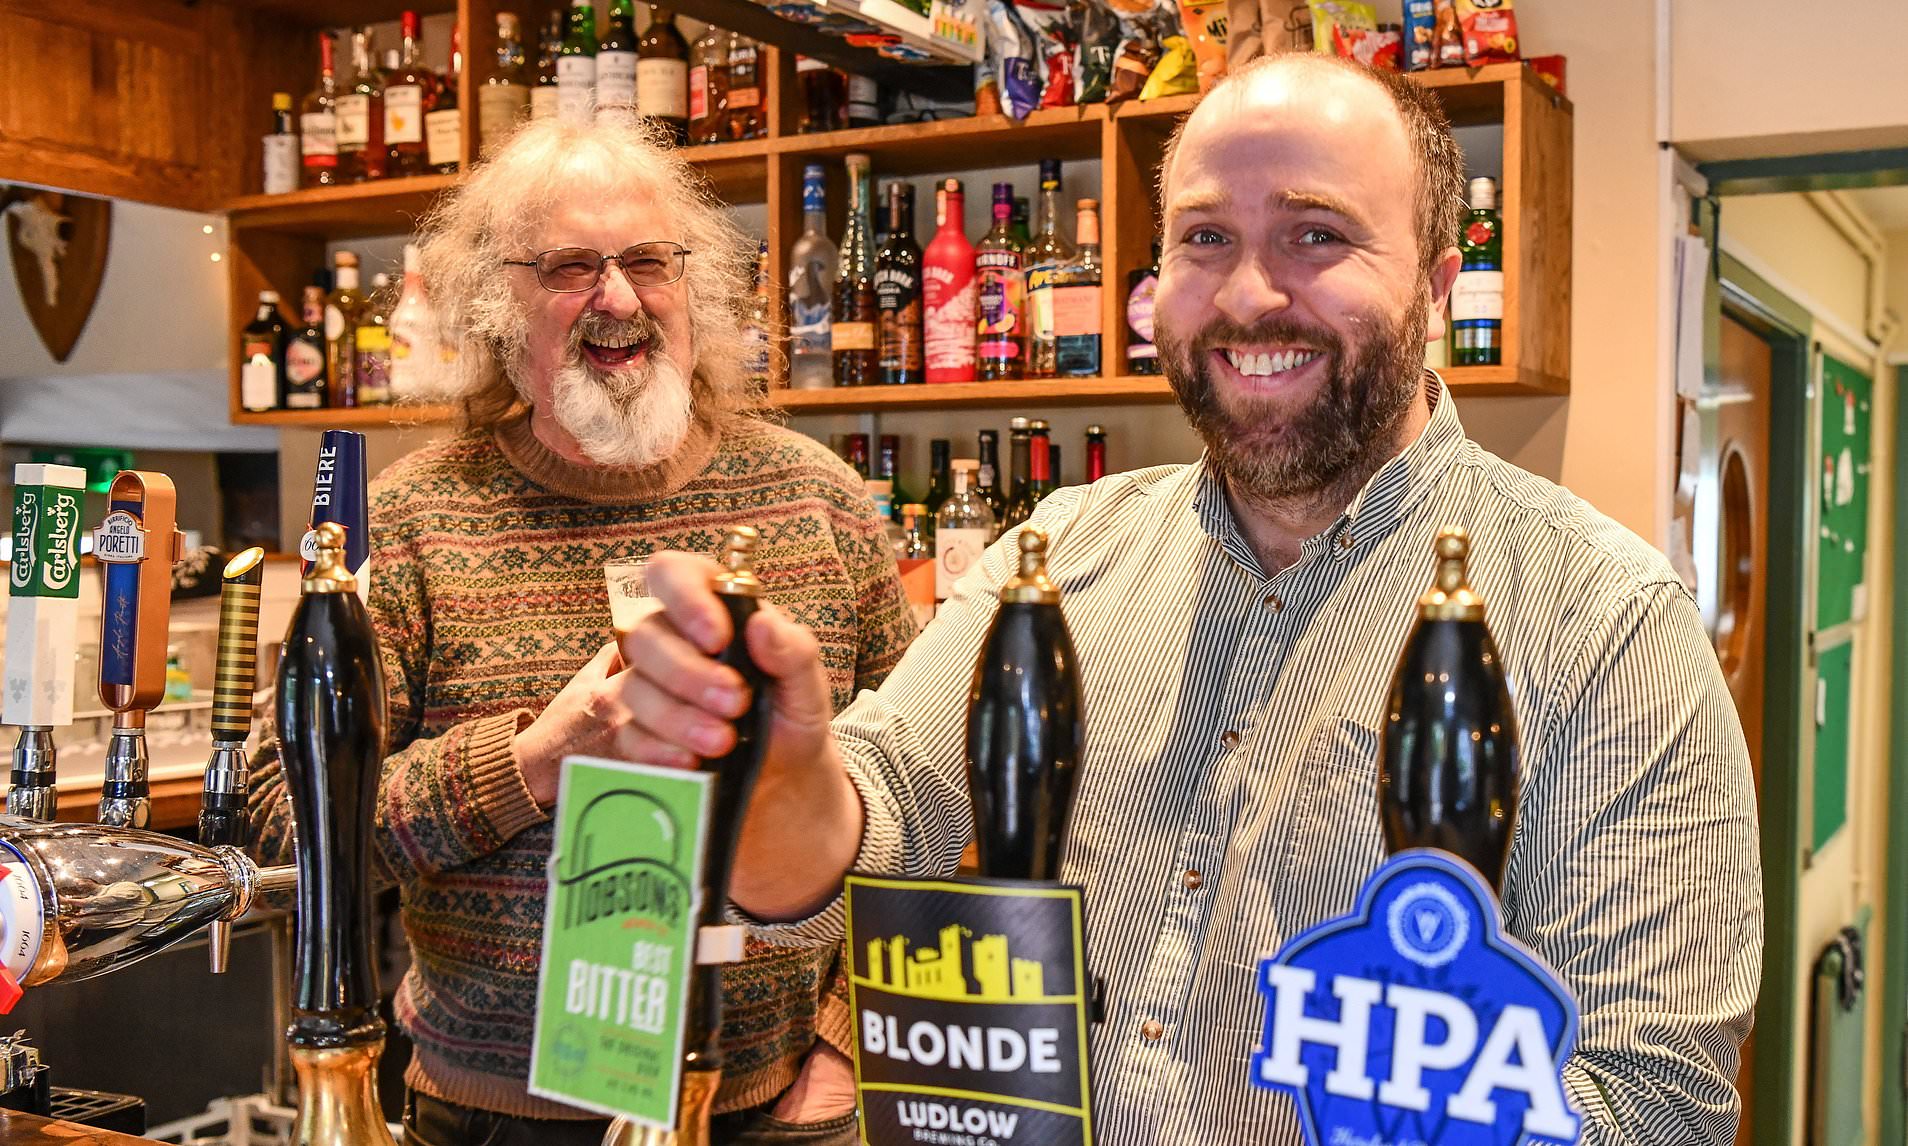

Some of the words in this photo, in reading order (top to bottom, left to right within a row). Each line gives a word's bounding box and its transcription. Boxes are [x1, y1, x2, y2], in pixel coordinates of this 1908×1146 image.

[315, 446, 337, 506] BIERE
[10, 491, 38, 589] Carlsberg
[42, 492, 79, 590] Carlsberg
[99, 534, 139, 553] PORETTI
[110, 525, 130, 535] ANGELO
[18, 930, 31, 958] 1664
[565, 958, 669, 1035] BITTER
[862, 1008, 1062, 1073] BLONDE
[1260, 964, 1582, 1141] HPA
[897, 1099, 1019, 1140] LUDLOW
[913, 1127, 975, 1146] BREWING
